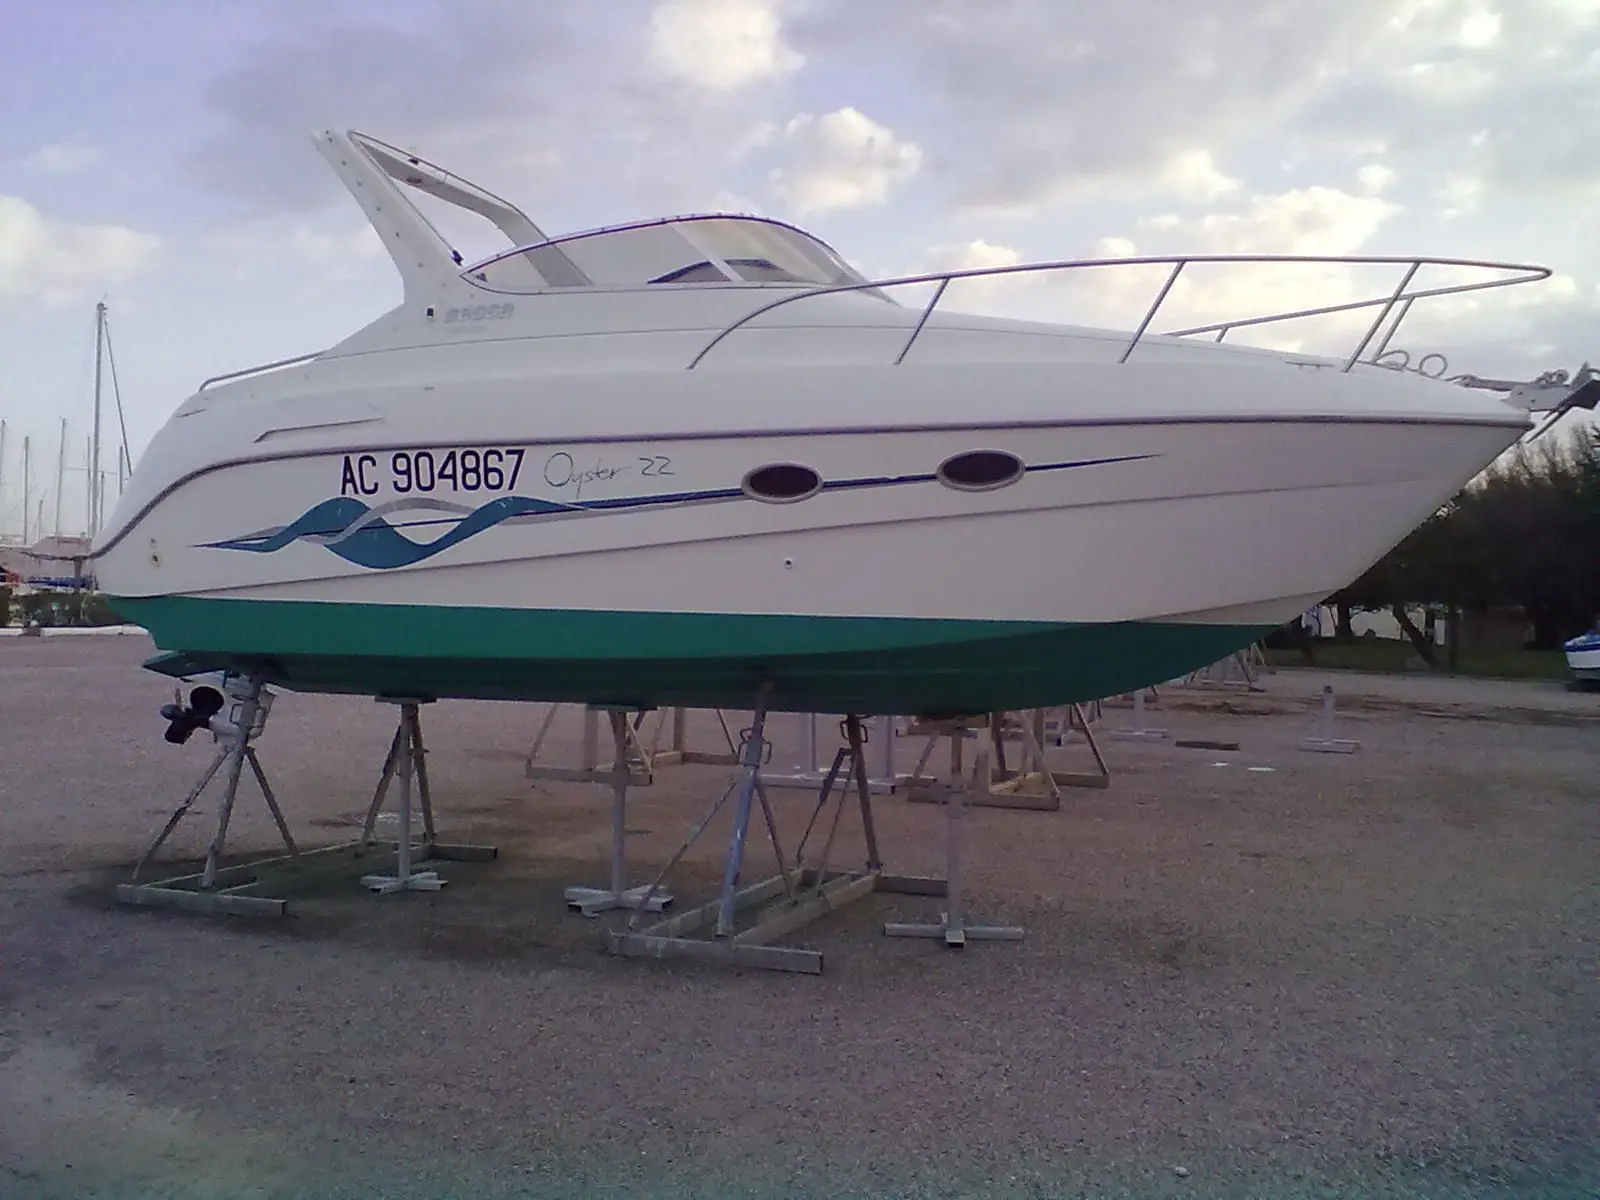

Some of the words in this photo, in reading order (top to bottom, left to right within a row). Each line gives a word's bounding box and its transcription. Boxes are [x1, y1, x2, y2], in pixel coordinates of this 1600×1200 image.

[341, 455, 379, 495] AC
[392, 449, 525, 493] 904867
[544, 452, 632, 499] Oyster
[638, 456, 676, 476] 22
